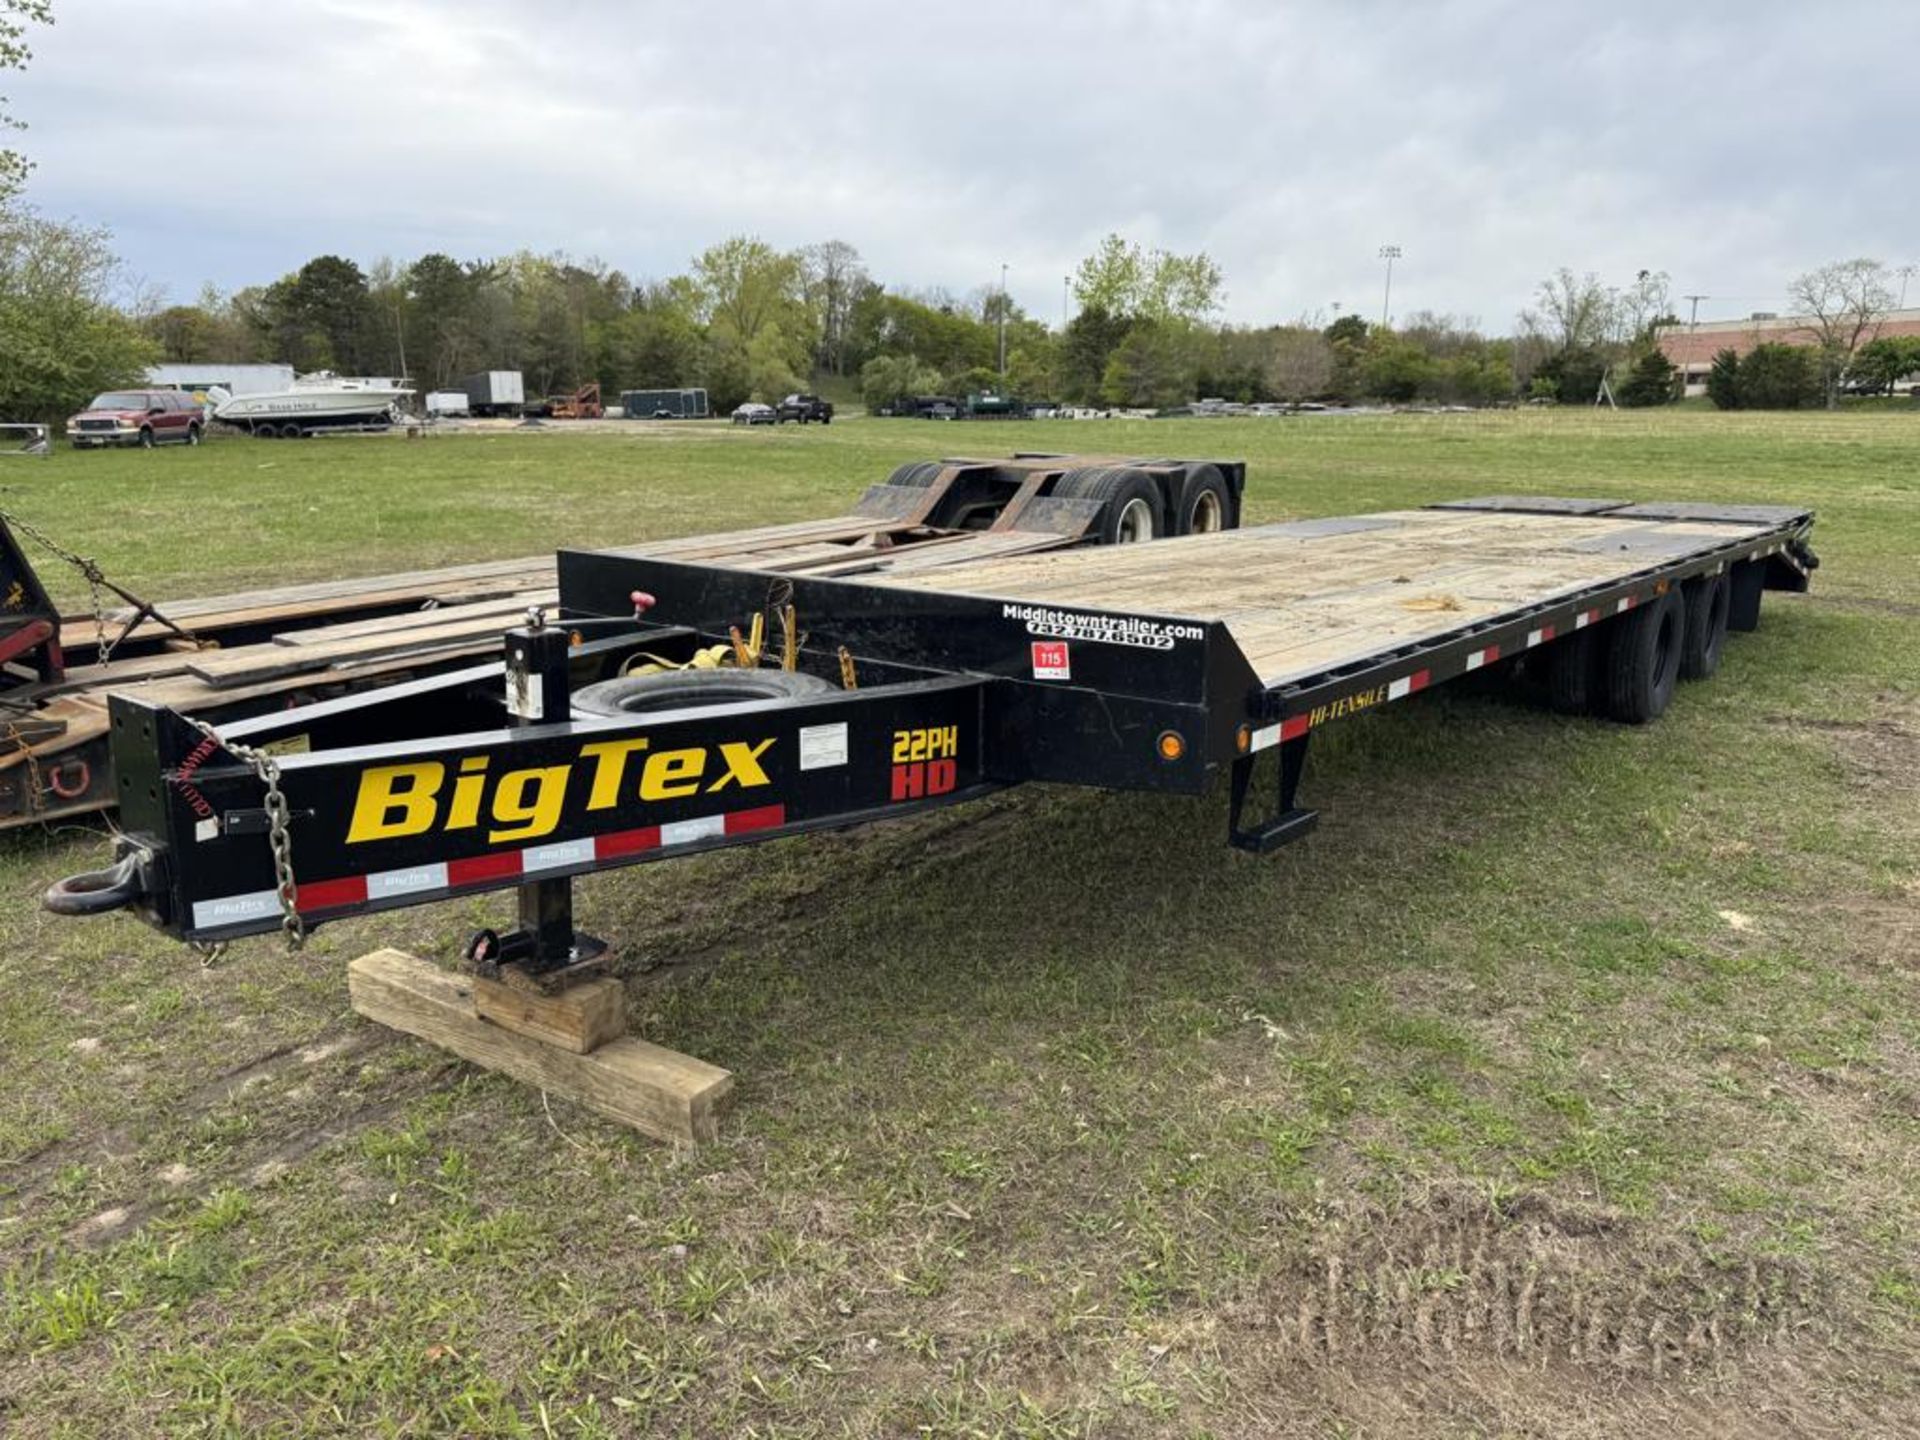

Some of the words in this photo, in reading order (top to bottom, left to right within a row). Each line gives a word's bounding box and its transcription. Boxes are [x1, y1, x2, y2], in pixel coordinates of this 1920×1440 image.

[1003, 604, 1203, 640] Middletowntrailer.com
[1041, 652, 1062, 666] 115
[1308, 683, 1388, 728] HI-TENSILE
[892, 725, 958, 763] 22PH
[345, 738, 777, 844] BigTex
[892, 759, 957, 800] HD
